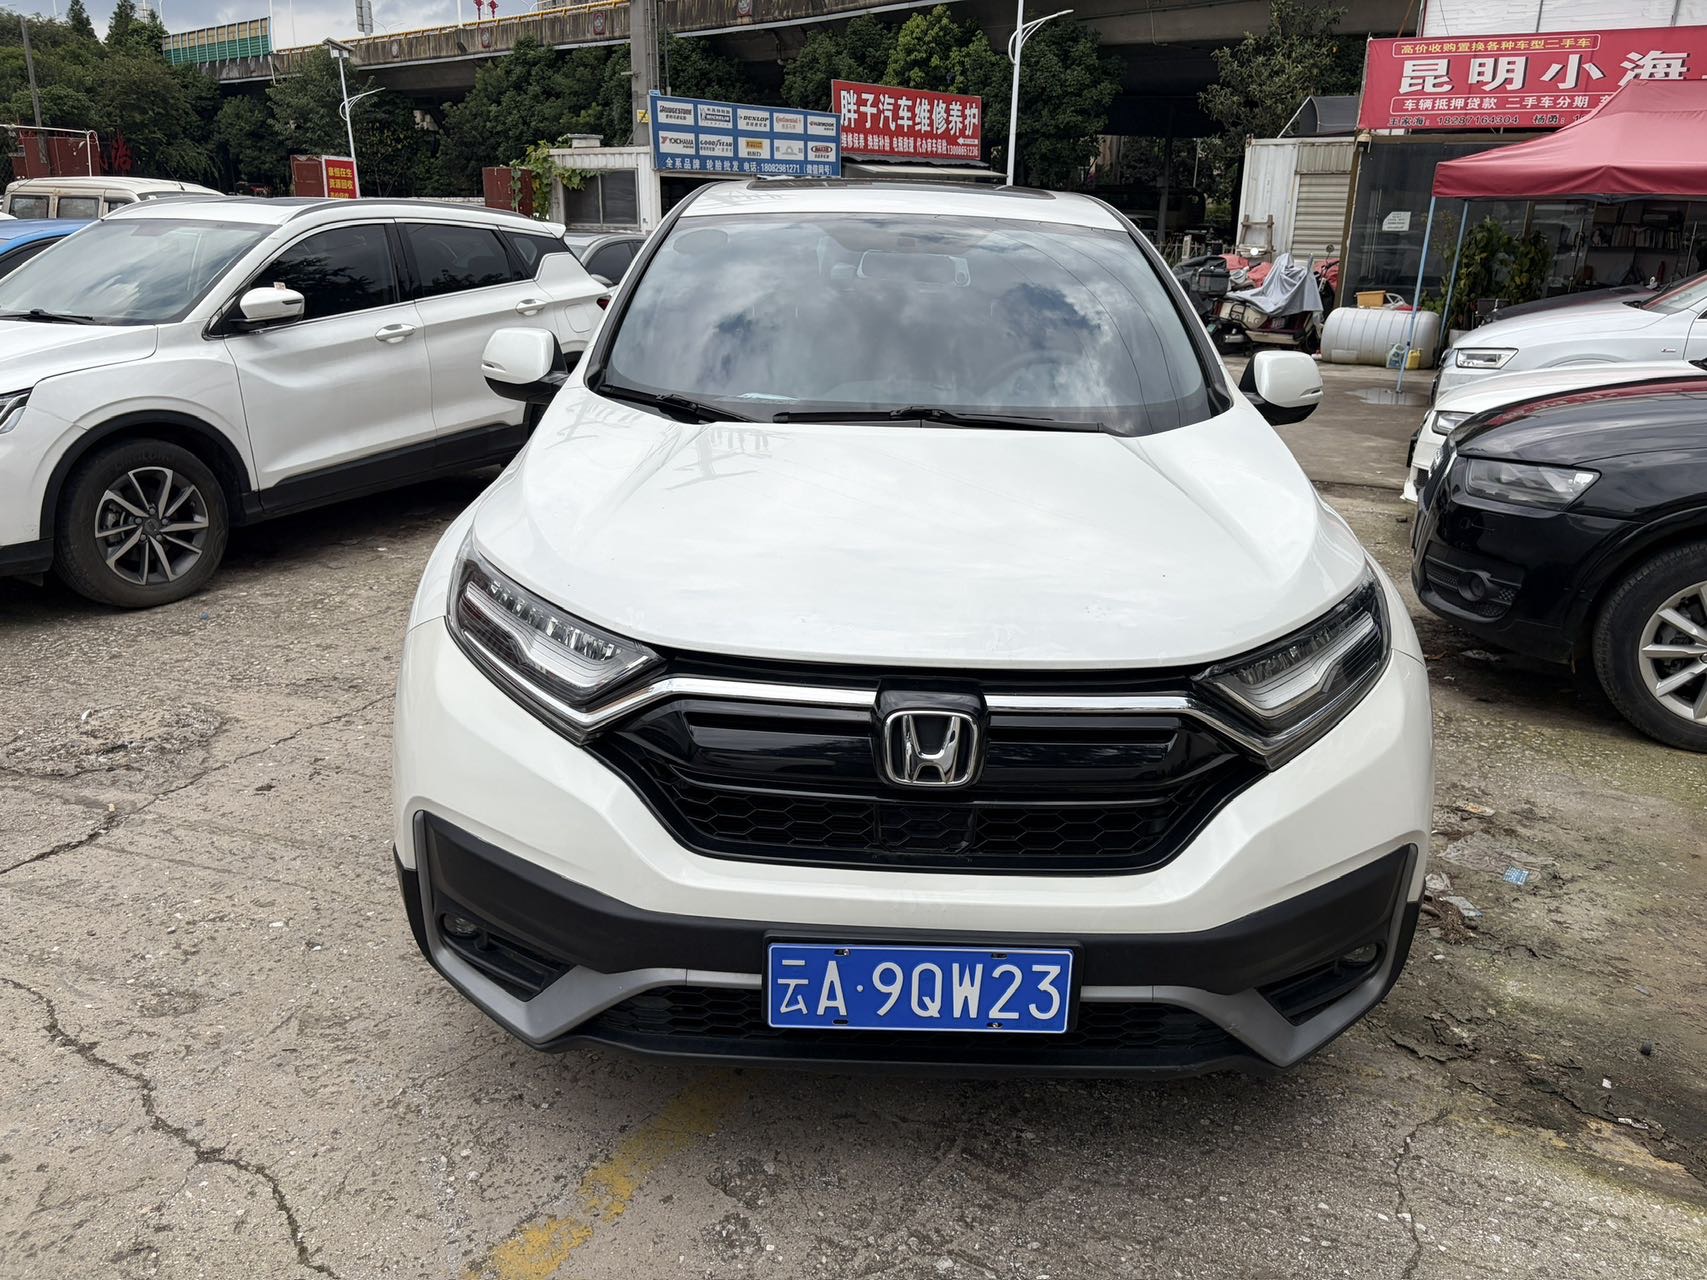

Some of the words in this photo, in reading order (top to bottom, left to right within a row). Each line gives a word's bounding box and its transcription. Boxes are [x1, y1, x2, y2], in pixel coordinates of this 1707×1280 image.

[1401, 38, 1591, 54] 高价收购置换各种车型二手车
[1399, 50, 1707, 93] 昆明小海
[840, 90, 979, 136] 胖子汽车维修养护
[1403, 97, 1497, 111] 车辆抵押贷款
[1505, 95, 1589, 108] 二手车分期
[665, 156, 700, 170] 全系品牌
[777, 959, 1061, 1020] 云A·9QW23
